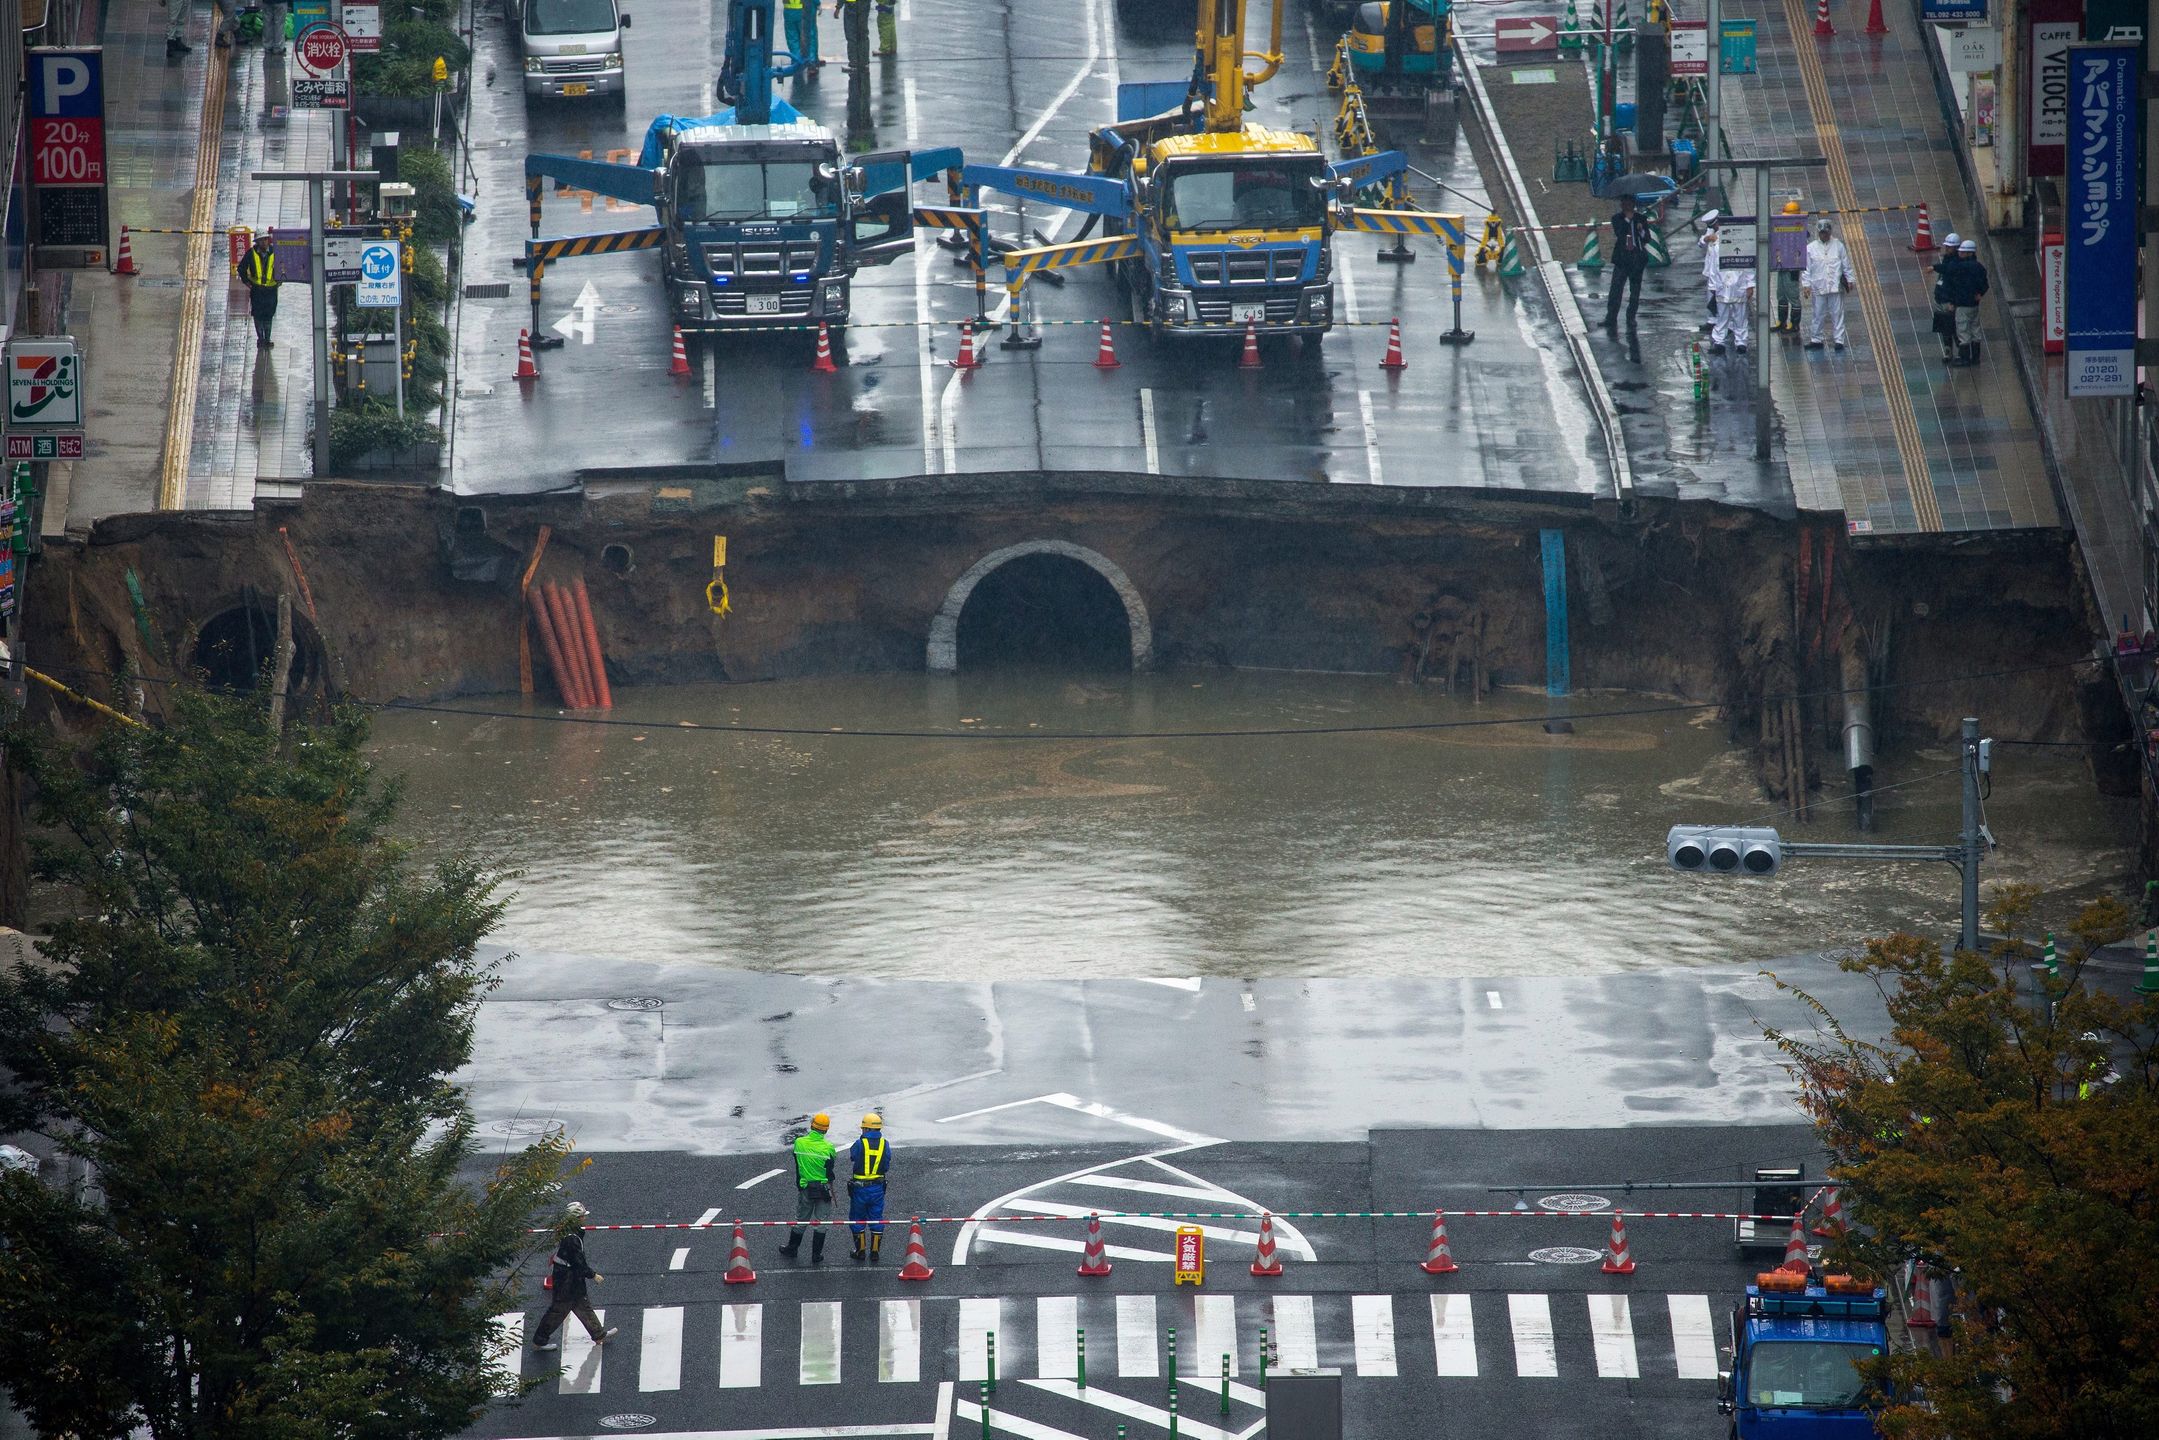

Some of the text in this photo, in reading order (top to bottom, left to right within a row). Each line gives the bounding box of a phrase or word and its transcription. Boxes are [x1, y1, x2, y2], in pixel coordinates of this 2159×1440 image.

[307, 42, 341, 58] 消火栓
[43, 57, 90, 115] P
[294, 81, 347, 94] とみや歯科
[2042, 50, 2066, 116] VELOCE
[44, 122, 90, 144] 20分
[2115, 58, 2127, 200] Dramatic Communication
[2082, 59, 2110, 246] アパマンショップ
[37, 147, 100, 179] 100円
[742, 227, 780, 235] ISUZU
[1228, 235, 1266, 243] ISUZU
[371, 264, 390, 274] 原付
[360, 294, 398, 304] この先 70m
[2053, 260, 2063, 324] Free Papers Land
[2085, 365, 2118, 374] (0120)
[2080, 374, 2122, 383] 027-291
[10, 441, 31, 454] ATM
[38, 440, 52, 454] 酒
[59, 440, 81, 454] たばこ
[1182, 1236, 1196, 1270] 火気厳禁
